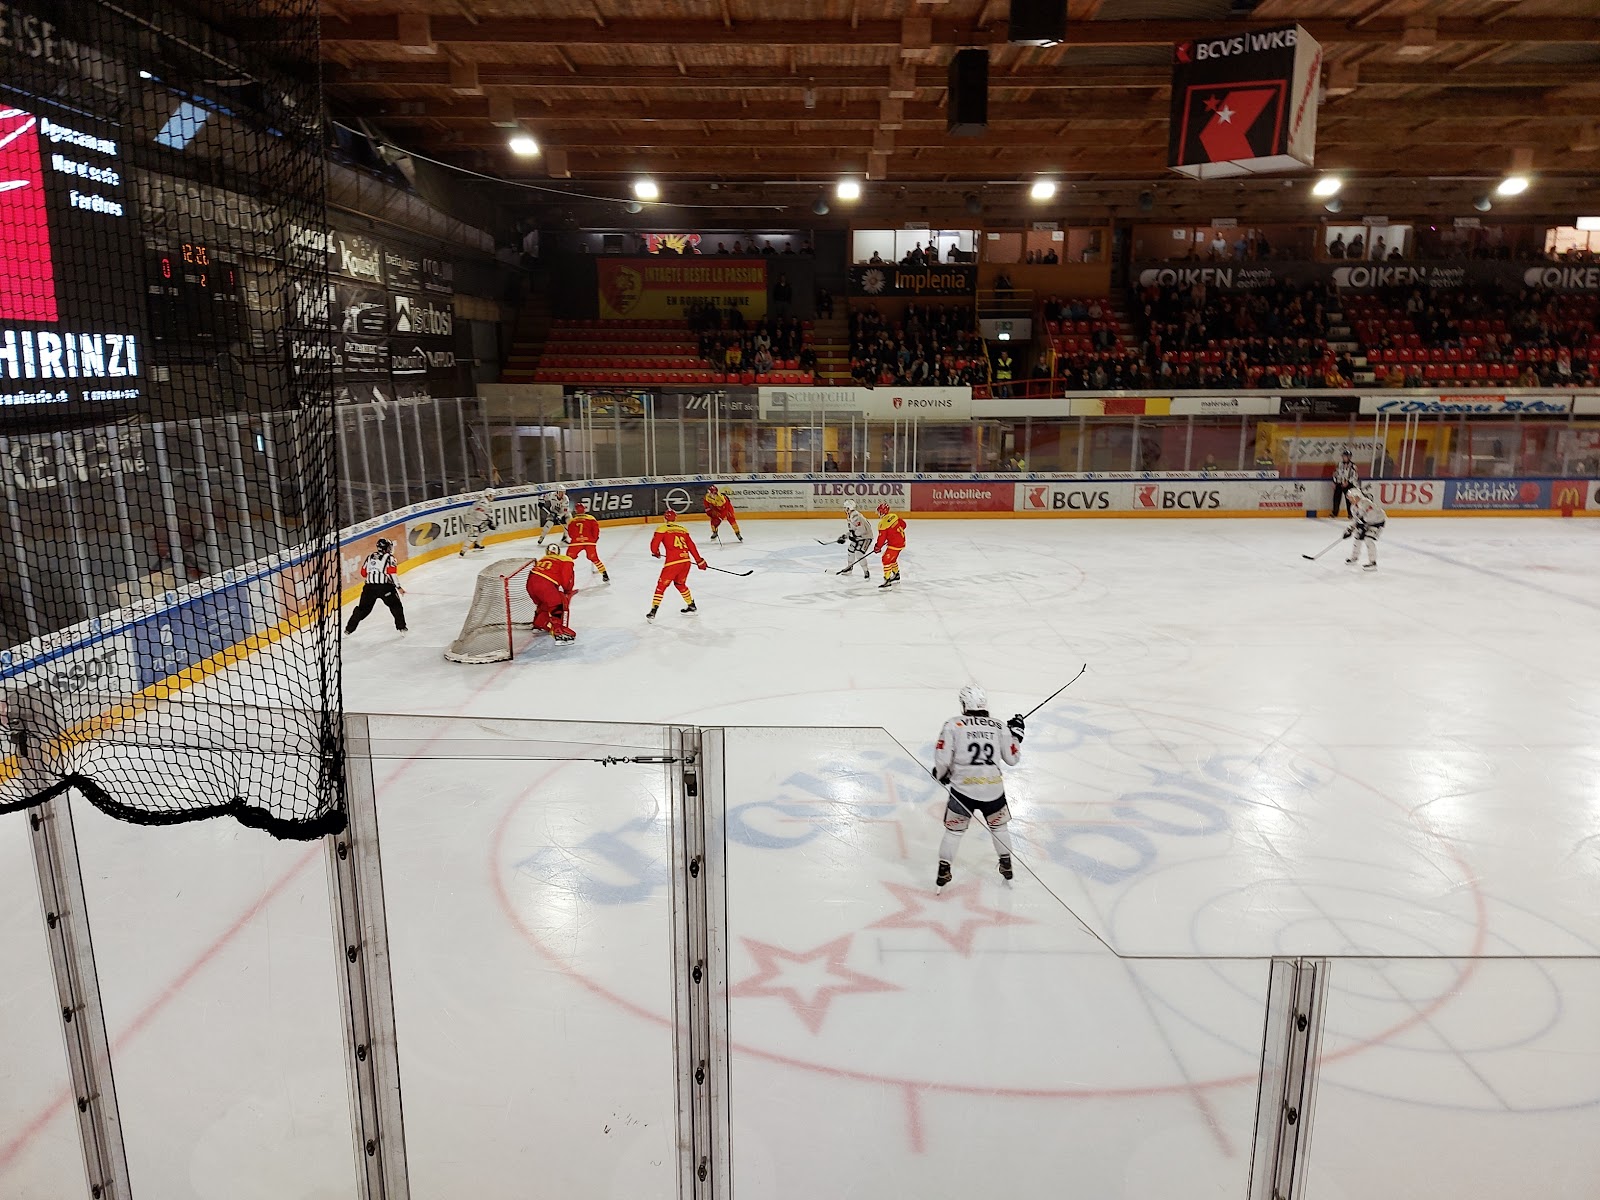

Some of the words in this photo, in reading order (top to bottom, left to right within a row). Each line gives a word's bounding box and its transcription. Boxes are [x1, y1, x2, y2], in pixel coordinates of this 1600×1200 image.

[896, 269, 966, 294] Implenia
[908, 400, 953, 409] PROVINS
[813, 483, 905, 496] ILECOLOR
[932, 489, 942, 499] la
[943, 488, 992, 499] Mobilière
[1379, 483, 1435, 505] UBS
[580, 492, 633, 513] atlas
[1053, 491, 1110, 510] BCVS
[1163, 491, 1220, 509] BCVS
[601, 510, 651, 520] AUTOMOBILES
[575, 523, 584, 535] 7
